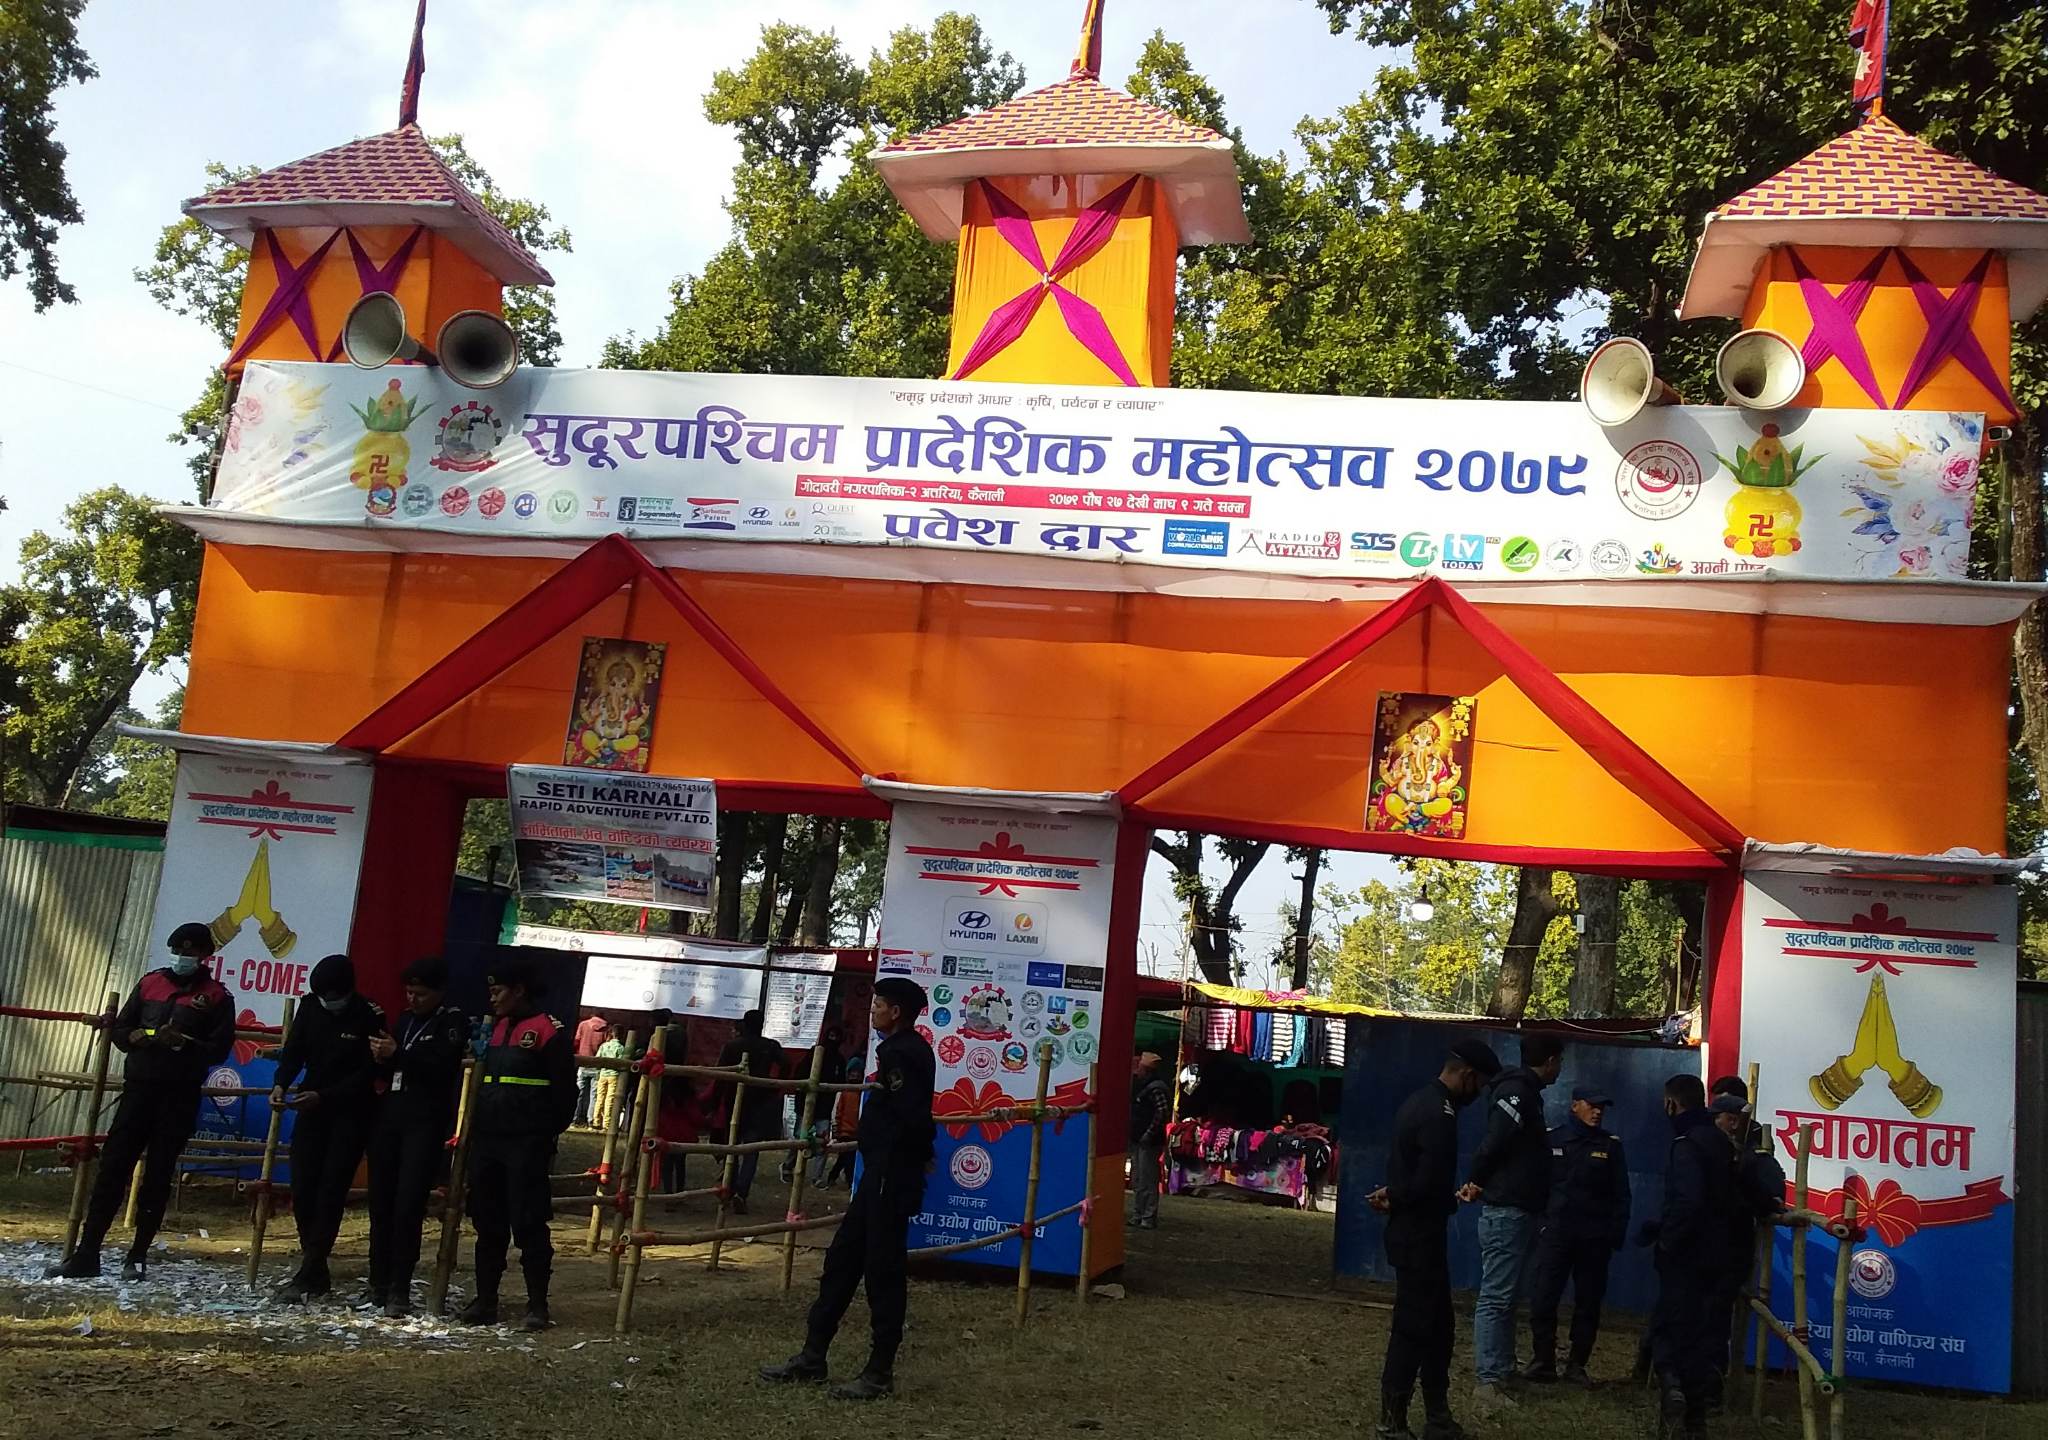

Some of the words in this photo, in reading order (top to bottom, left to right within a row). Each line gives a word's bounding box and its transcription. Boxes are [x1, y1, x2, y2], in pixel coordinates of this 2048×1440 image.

[930, 391, 973, 405] प्रदेशको
[978, 393, 1013, 406] आधार
[524, 404, 843, 470] सुदूरपश्चिम
[864, 414, 1112, 477] प्रादेशिक
[1134, 425, 1395, 490] महोत्सव
[1416, 445, 1588, 498] २०७९
[800, 479, 841, 494] गोदावरी
[967, 486, 1005, 503] कैलाली
[1082, 491, 1103, 507] पौष
[1106, 496, 1122, 507] २७
[1192, 497, 1213, 513] गते
[883, 508, 1020, 547] प्रवेश
[1040, 520, 1152, 554] द्वार
[1269, 532, 1322, 543] RADIO
[1266, 543, 1340, 559] ATTARIYA
[1442, 560, 1483, 570] TODAY
[536, 781, 585, 799] SETI
[592, 786, 694, 808] KARNALI
[519, 799, 563, 811] RAPID
[566, 803, 651, 820] ADVENTURE
[976, 860, 1013, 875] प्रादेशिक
[949, 929, 997, 941] HYUNDAI
[1006, 934, 1039, 945] LAXMI
[1785, 931, 1847, 948] सुदूरपश्चिम
[1849, 934, 1894, 950] प्रादेशिक
[1897, 938, 1942, 955] महोत्सव
[1775, 1110, 1976, 1171] स्वागतम
[947, 1192, 989, 1209] आयोजक
[1846, 1302, 1896, 1321] आयोजक
[1878, 1326, 1936, 1350] वाणिज्य
[1940, 1336, 1967, 1354] संघ
[1874, 1348, 1916, 1370] कैलाली
